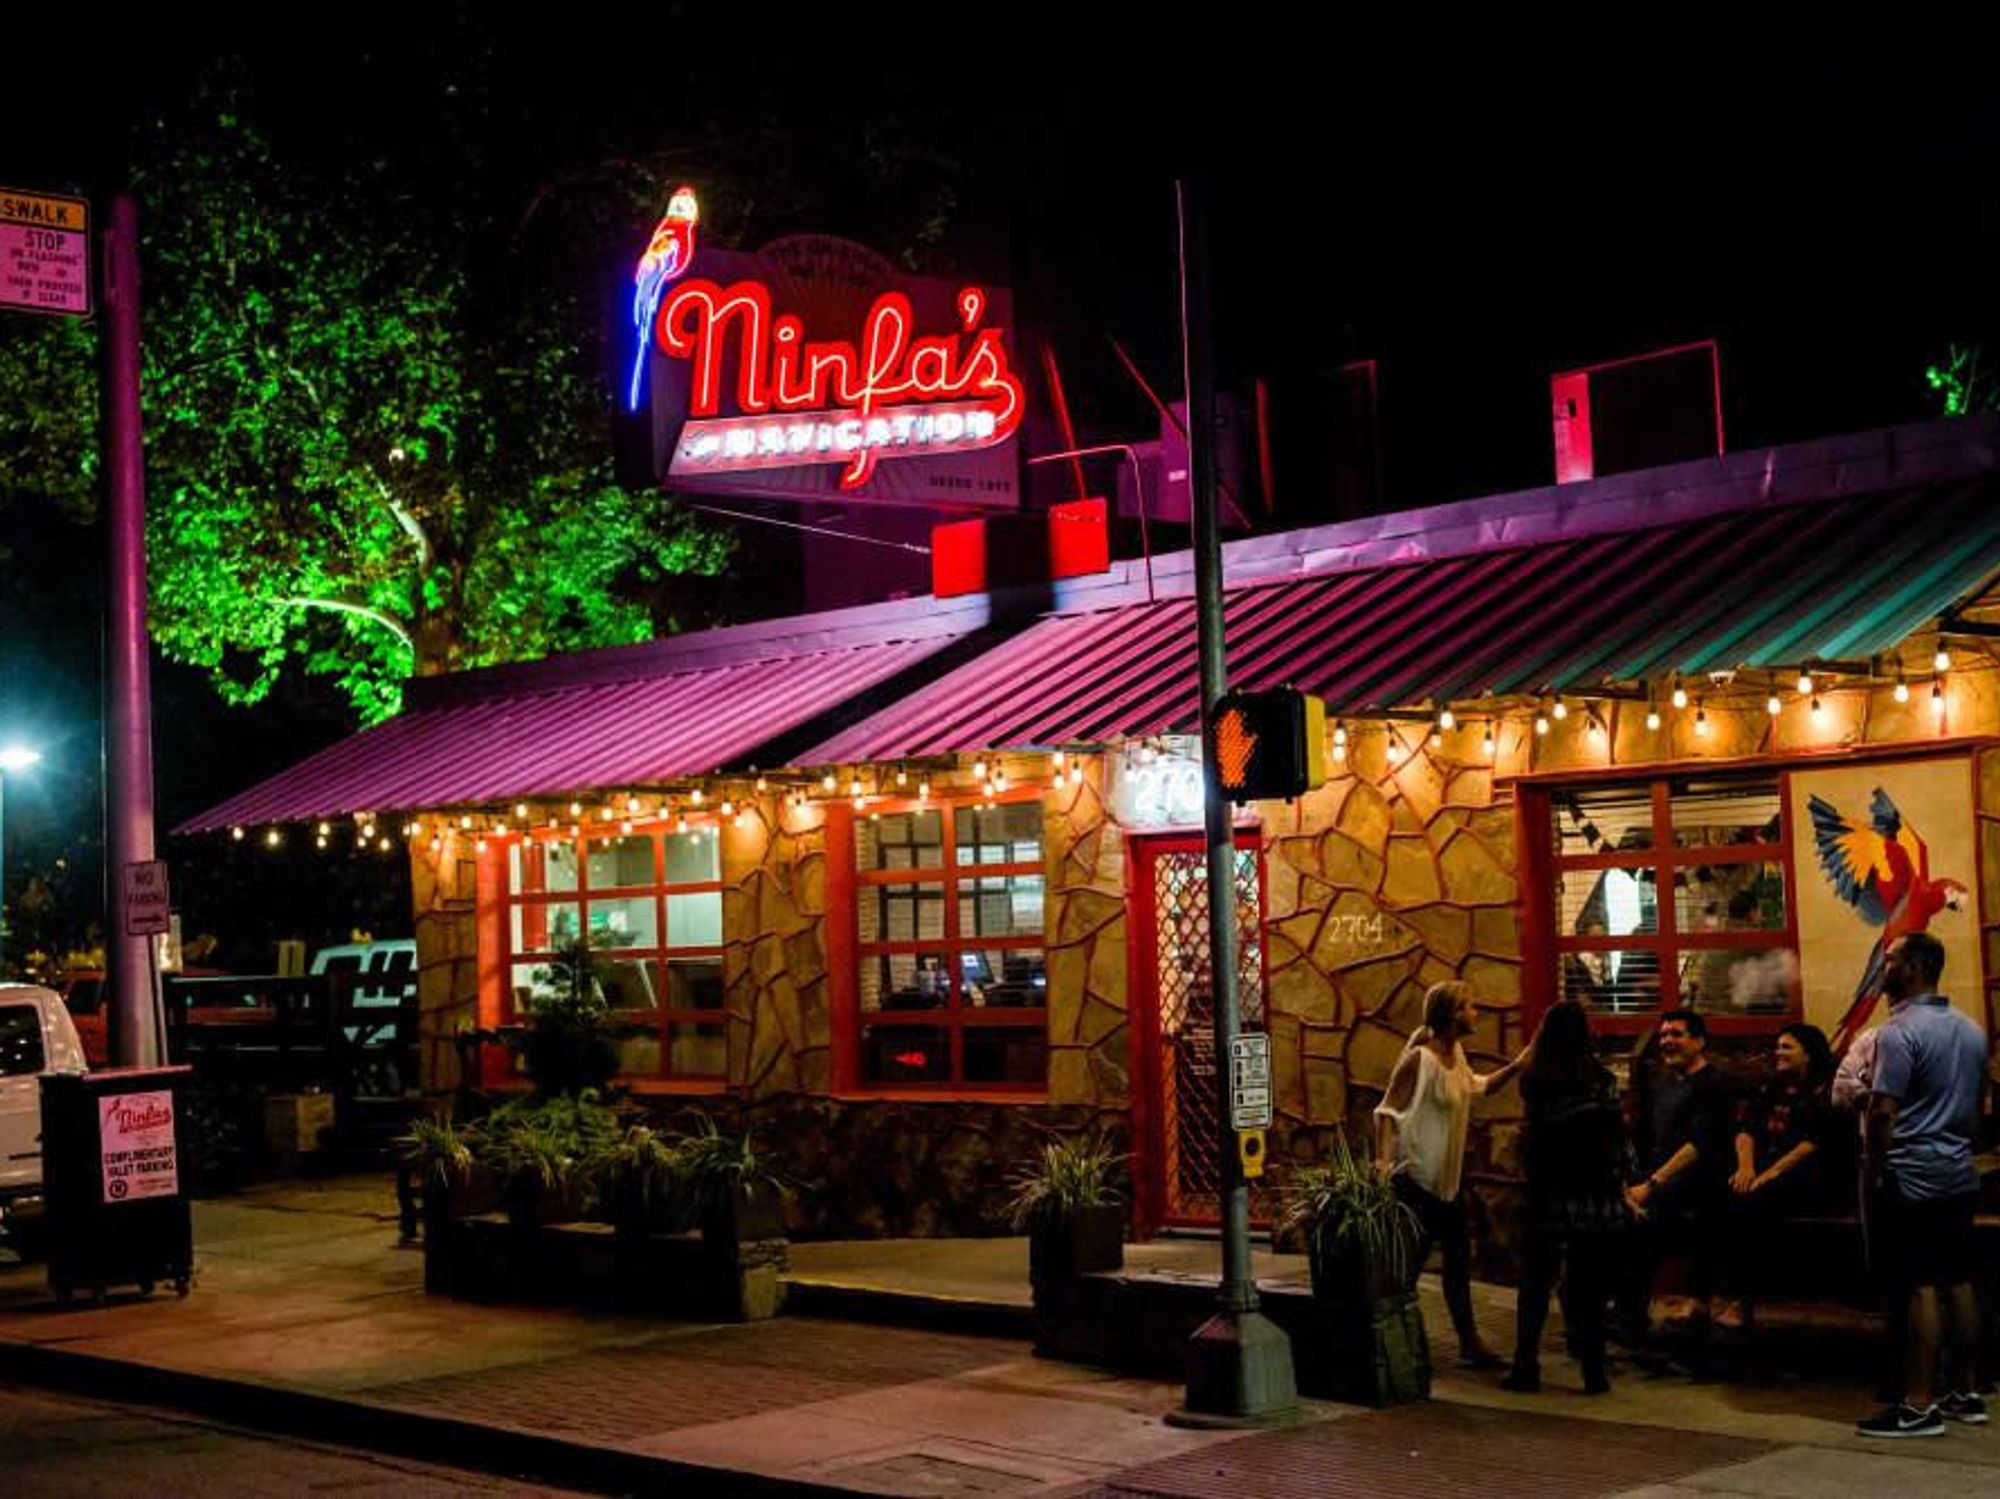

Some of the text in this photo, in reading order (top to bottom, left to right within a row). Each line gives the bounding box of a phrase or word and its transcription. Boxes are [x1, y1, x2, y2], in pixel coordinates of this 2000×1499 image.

[25, 229, 66, 251] STOP
[655, 279, 1024, 491] Ninfa's
[725, 409, 997, 459] NAVIGATION
[134, 871, 155, 886] NO
[1329, 912, 1384, 942] 2704
[104, 1146, 174, 1164] COMPLIMENTARY
[107, 1159, 174, 1178] VALET PARKING
